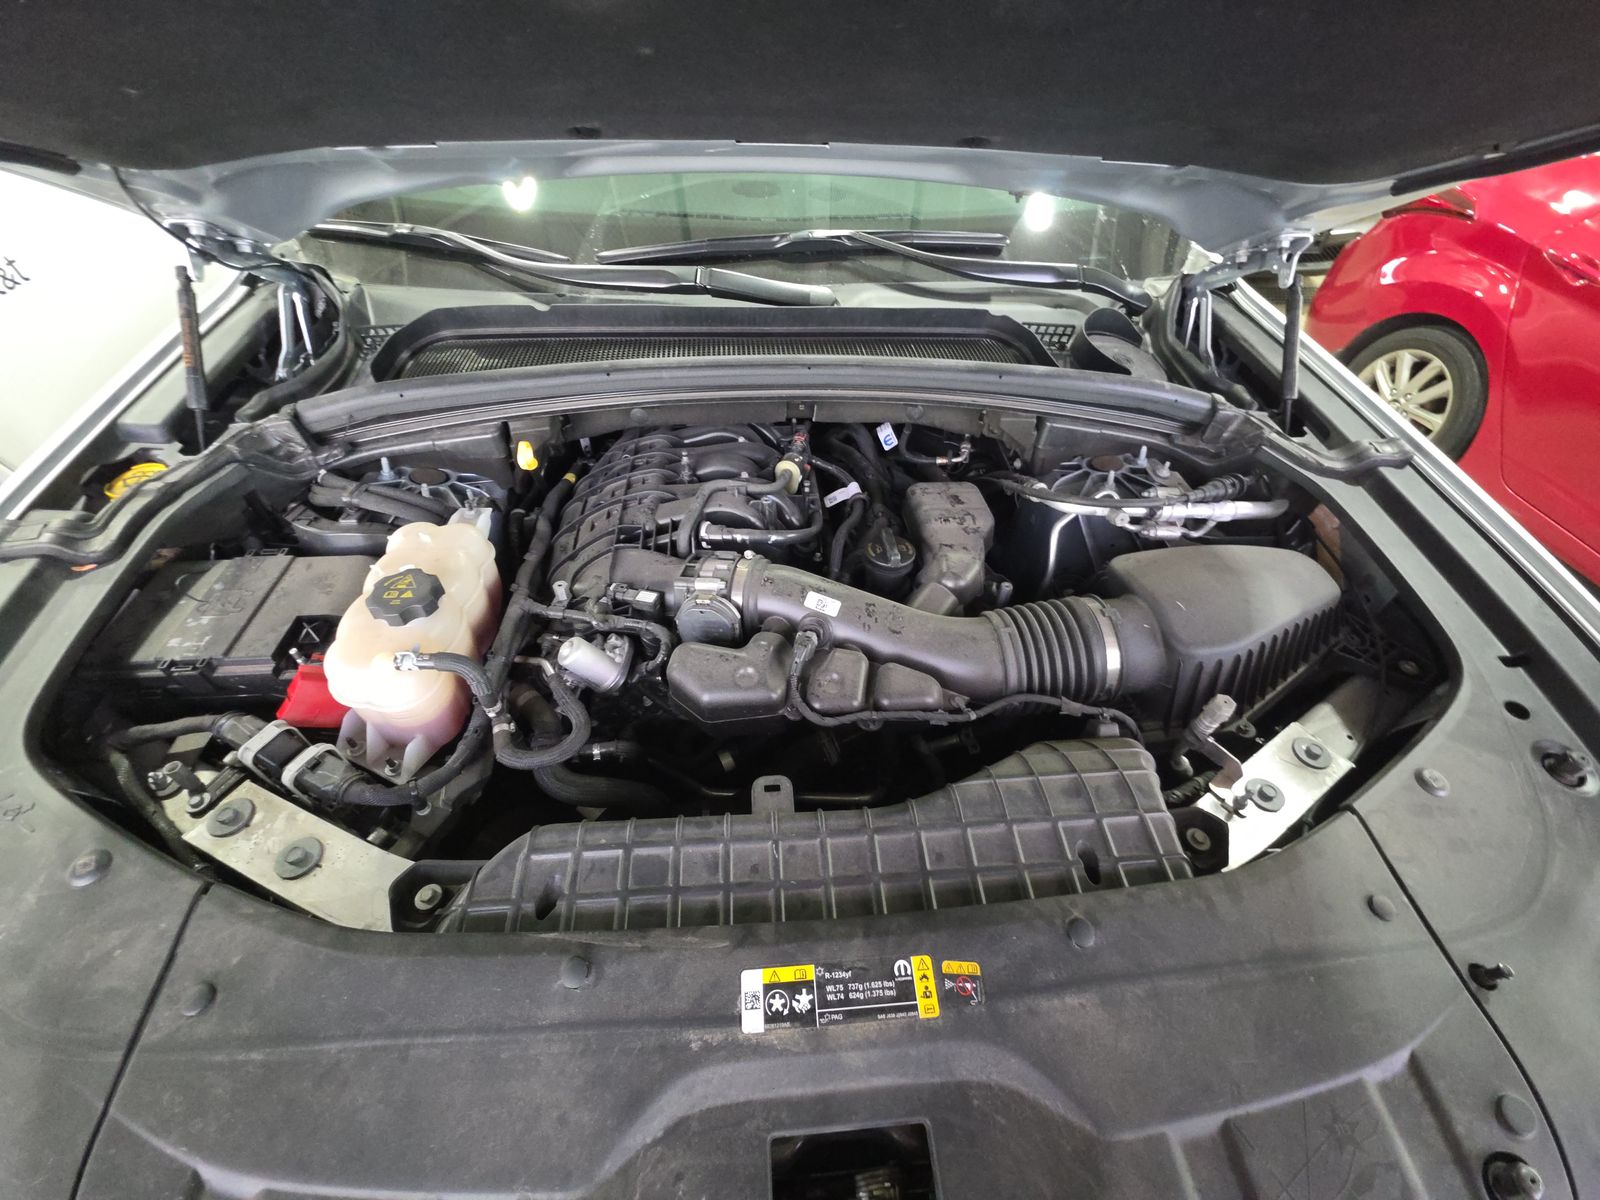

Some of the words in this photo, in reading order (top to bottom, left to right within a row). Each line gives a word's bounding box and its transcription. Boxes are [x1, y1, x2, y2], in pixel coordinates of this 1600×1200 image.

[825, 970, 852, 979] R-1234yf
[847, 982, 863, 991] 737g
[826, 993, 845, 1001] WL74
